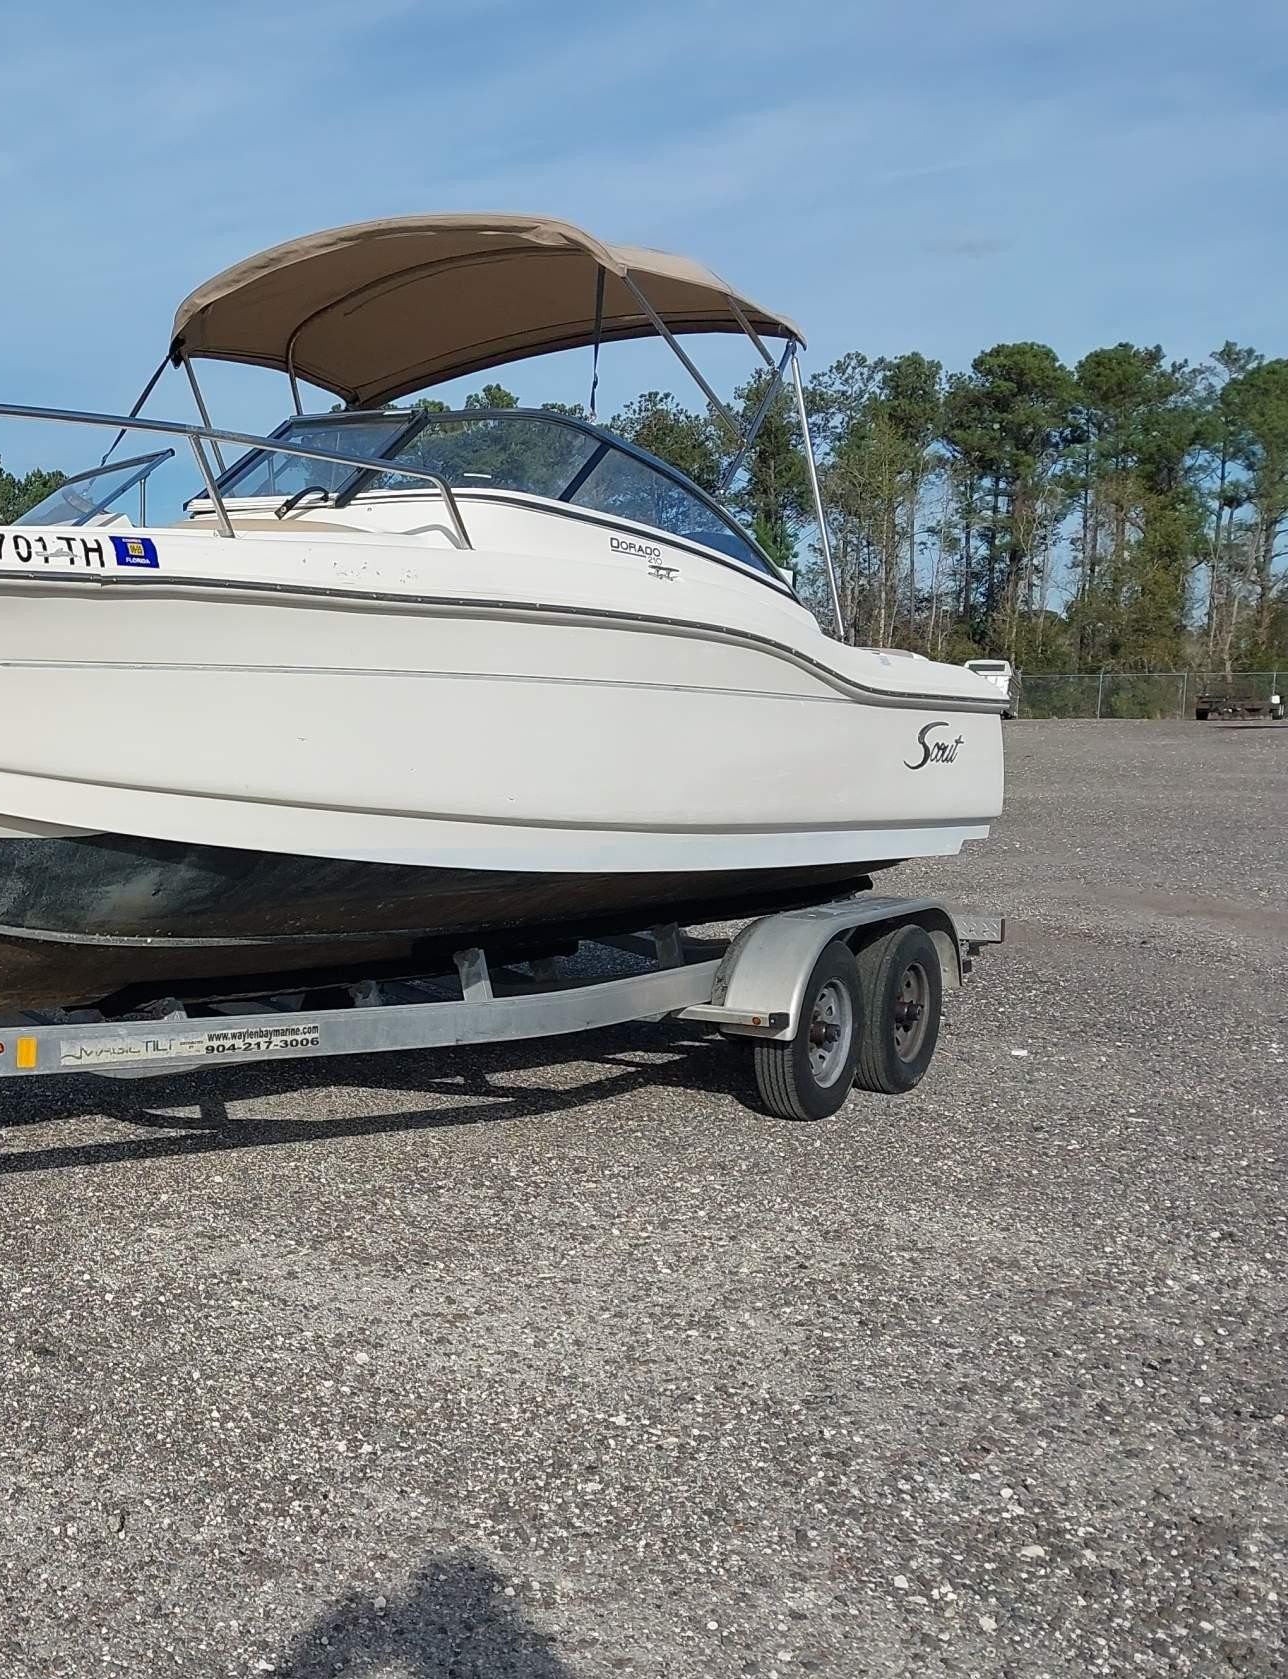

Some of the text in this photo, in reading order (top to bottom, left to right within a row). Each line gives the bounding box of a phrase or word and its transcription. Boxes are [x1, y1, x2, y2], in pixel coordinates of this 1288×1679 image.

[55, 536, 106, 568] TH
[610, 536, 661, 557] DORADO
[903, 721, 965, 770] Scout
[207, 1025, 319, 1042] www.waylenbaymarine.com
[205, 1037, 320, 1054] 904-217-3006
